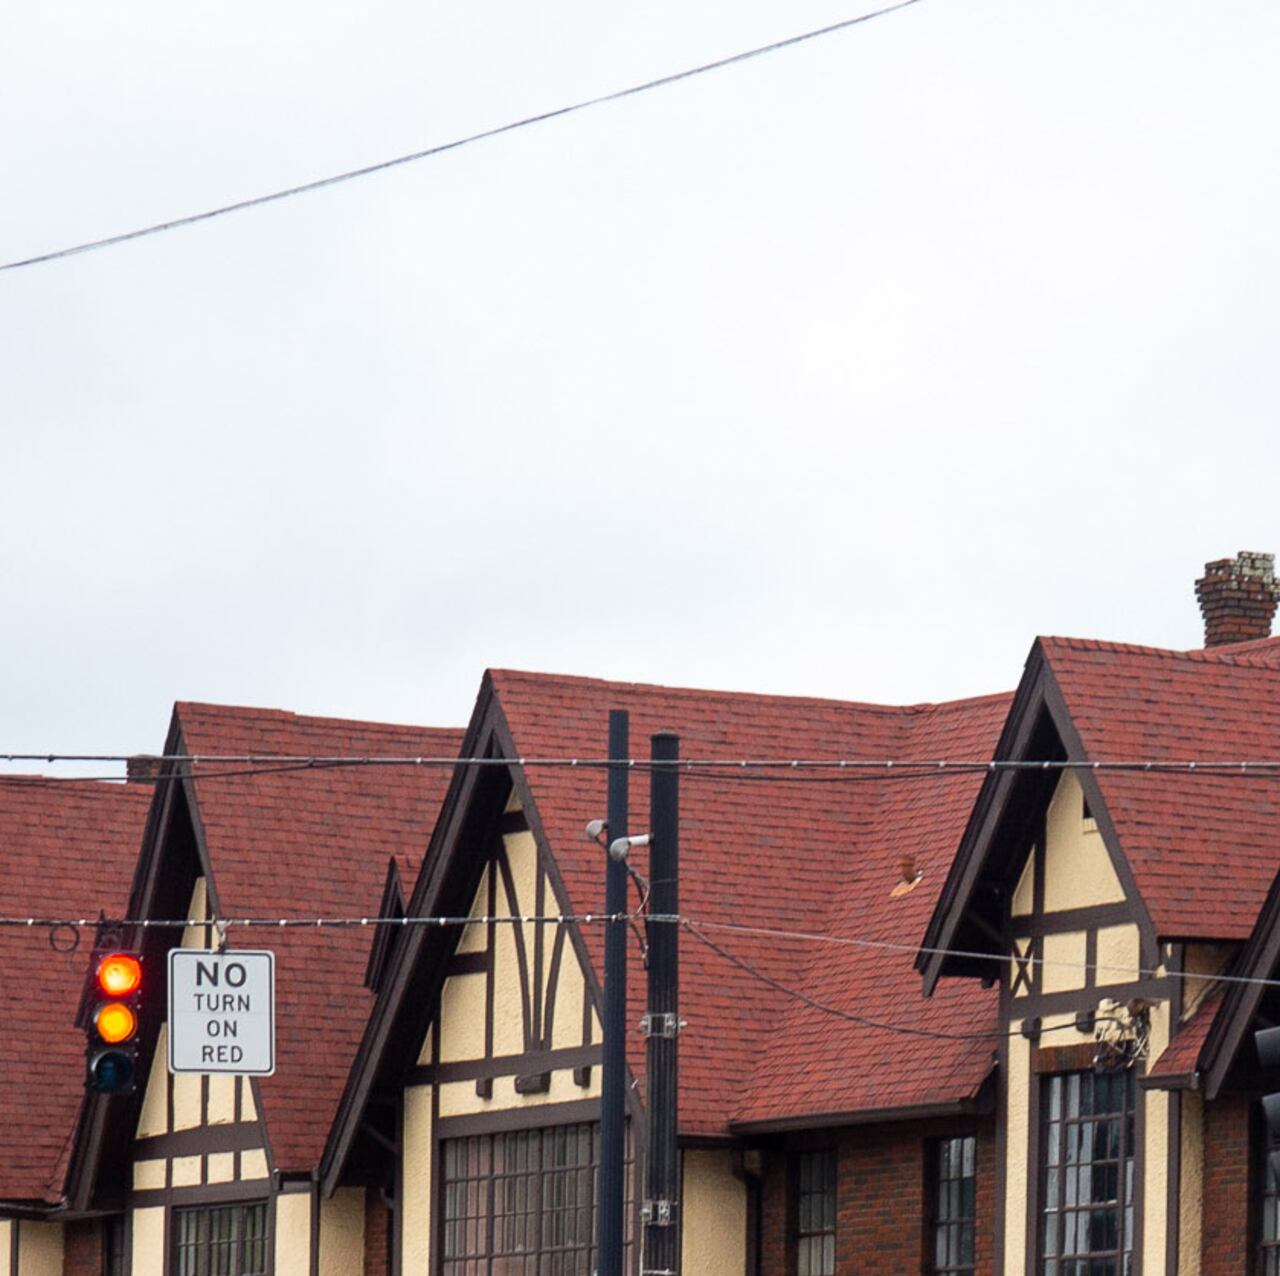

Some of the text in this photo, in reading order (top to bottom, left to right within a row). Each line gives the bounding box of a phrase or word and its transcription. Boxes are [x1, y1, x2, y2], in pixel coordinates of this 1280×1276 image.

[196, 962, 247, 987] NO
[194, 993, 251, 1012] TURN
[207, 1020, 238, 1038] ON
[202, 1046, 244, 1063] RED
